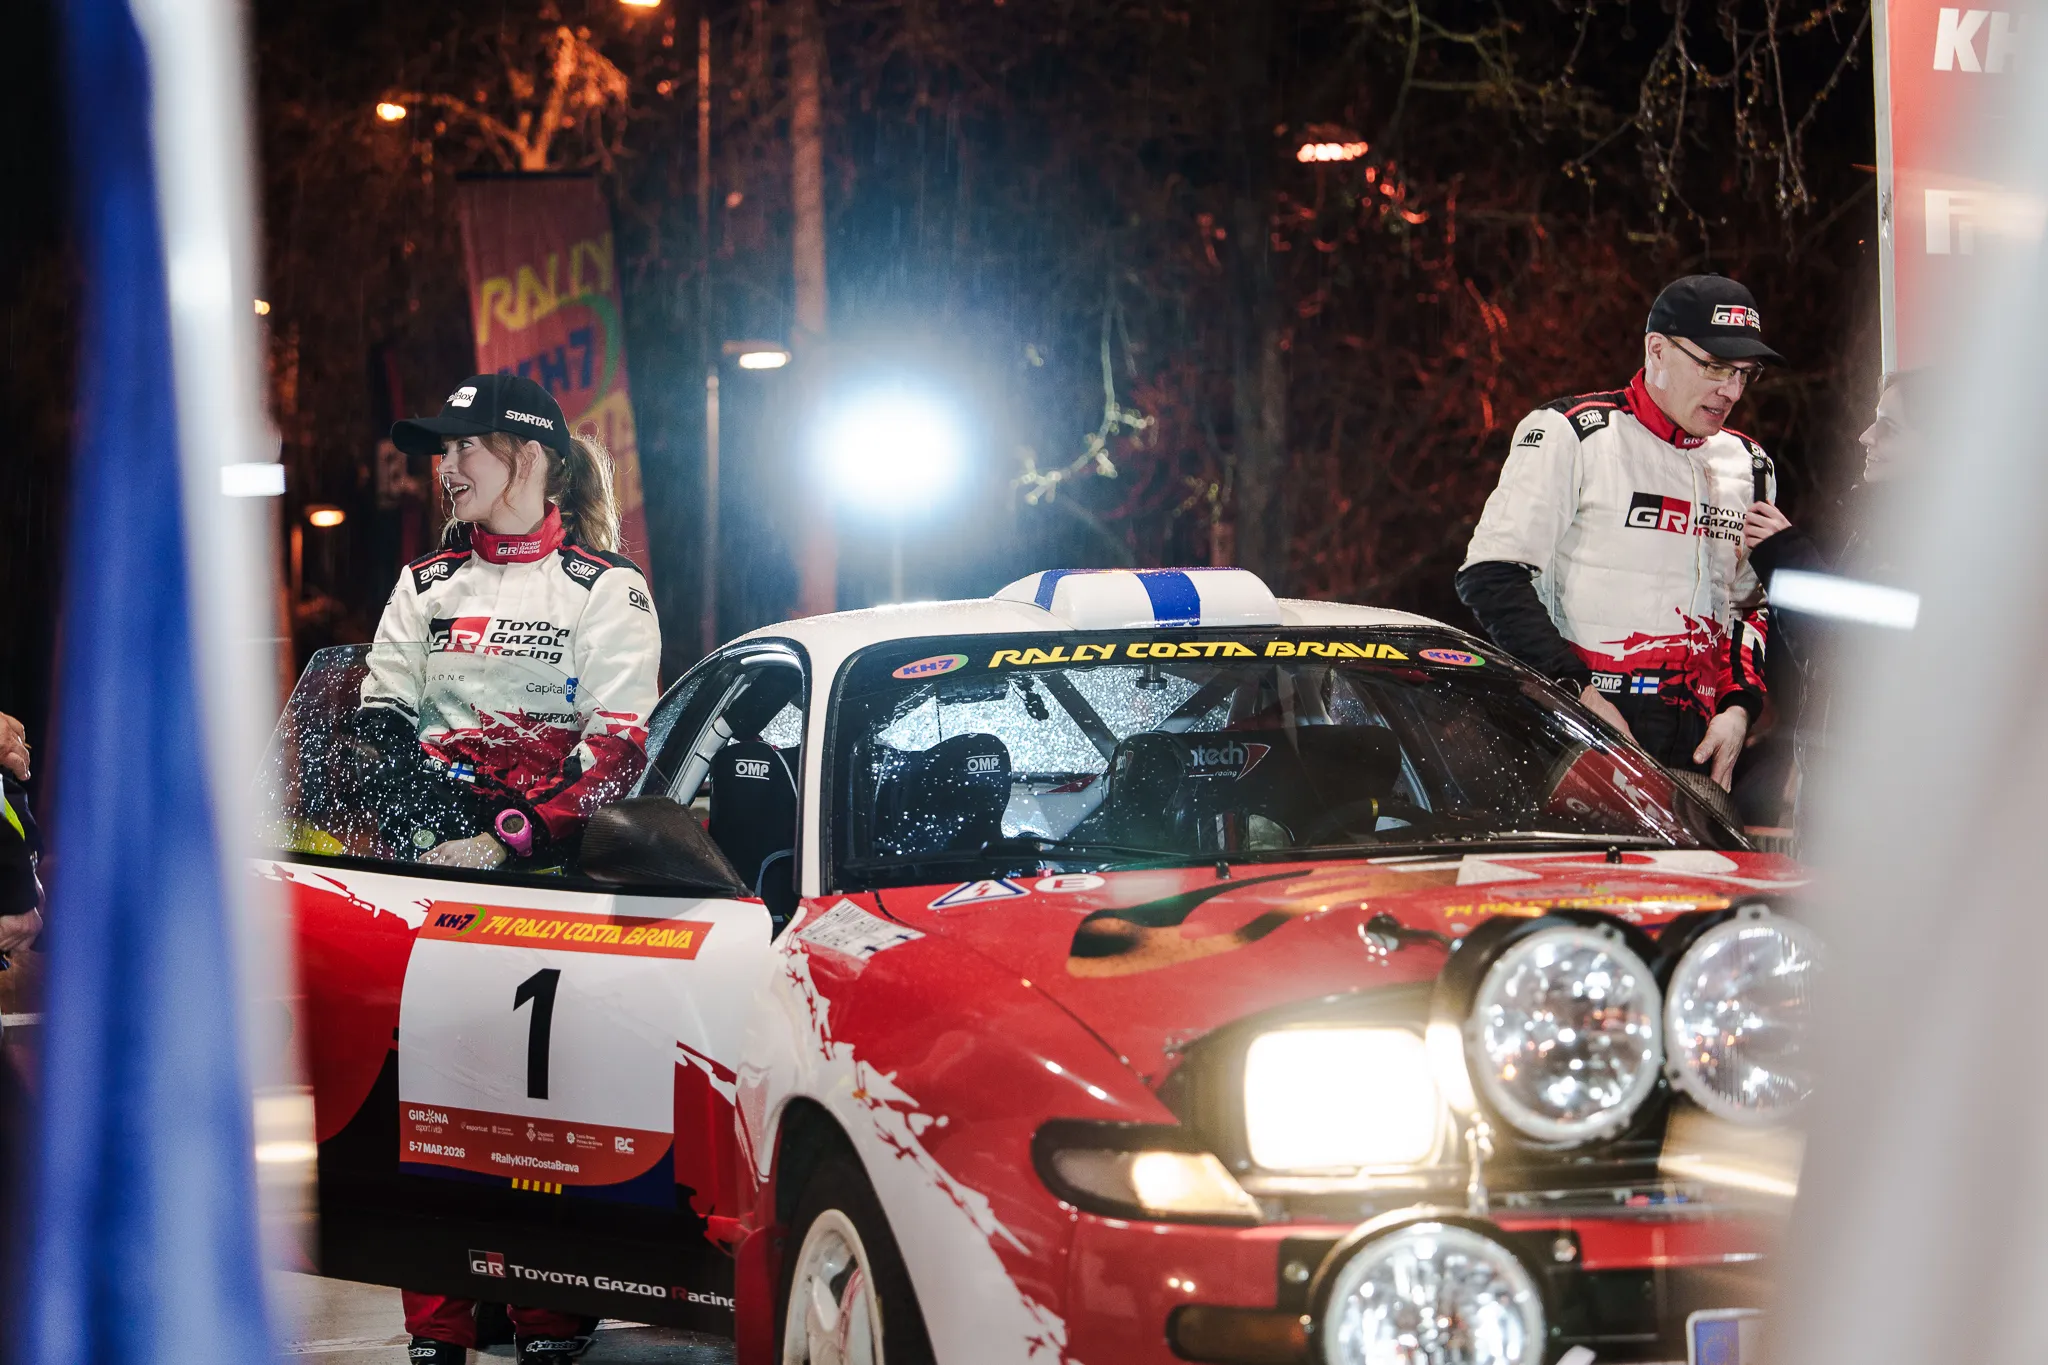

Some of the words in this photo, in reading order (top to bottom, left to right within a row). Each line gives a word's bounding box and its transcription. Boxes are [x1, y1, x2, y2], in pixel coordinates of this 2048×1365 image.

[1714, 311, 1744, 325] GR
[505, 409, 554, 431] STARTAX
[1579, 412, 1603, 427] OMP
[1522, 431, 1544, 444] MP
[1628, 506, 1688, 533] GR
[1692, 527, 1742, 546] Racing
[497, 546, 518, 556] GR
[420, 563, 449, 581] OMP
[569, 561, 597, 577] OMP
[430, 629, 481, 654] GR
[483, 645, 563, 665] Racing
[988, 643, 1117, 668] RALLY
[1126, 641, 1257, 659] COSTA
[1264, 641, 1410, 660] BRAVA
[1590, 676, 1623, 690] OMP
[735, 761, 770, 777] OMP
[966, 757, 1000, 772] OMP
[481, 915, 514, 935] 74
[504, 917, 569, 939] RALLY
[562, 922, 623, 944] COSTA
[621, 926, 694, 948] BRAVA
[513, 968, 561, 1100] 1
[409, 1140, 423, 1152] 5-7
[423, 1142, 443, 1156] MAR
[443, 1145, 466, 1159] 2026
[491, 1151, 580, 1173] #RallyKH7CostaBrava
[472, 1259, 505, 1277] GR
[509, 1264, 590, 1288] TOYOTA
[593, 1275, 667, 1299] GAZOO
